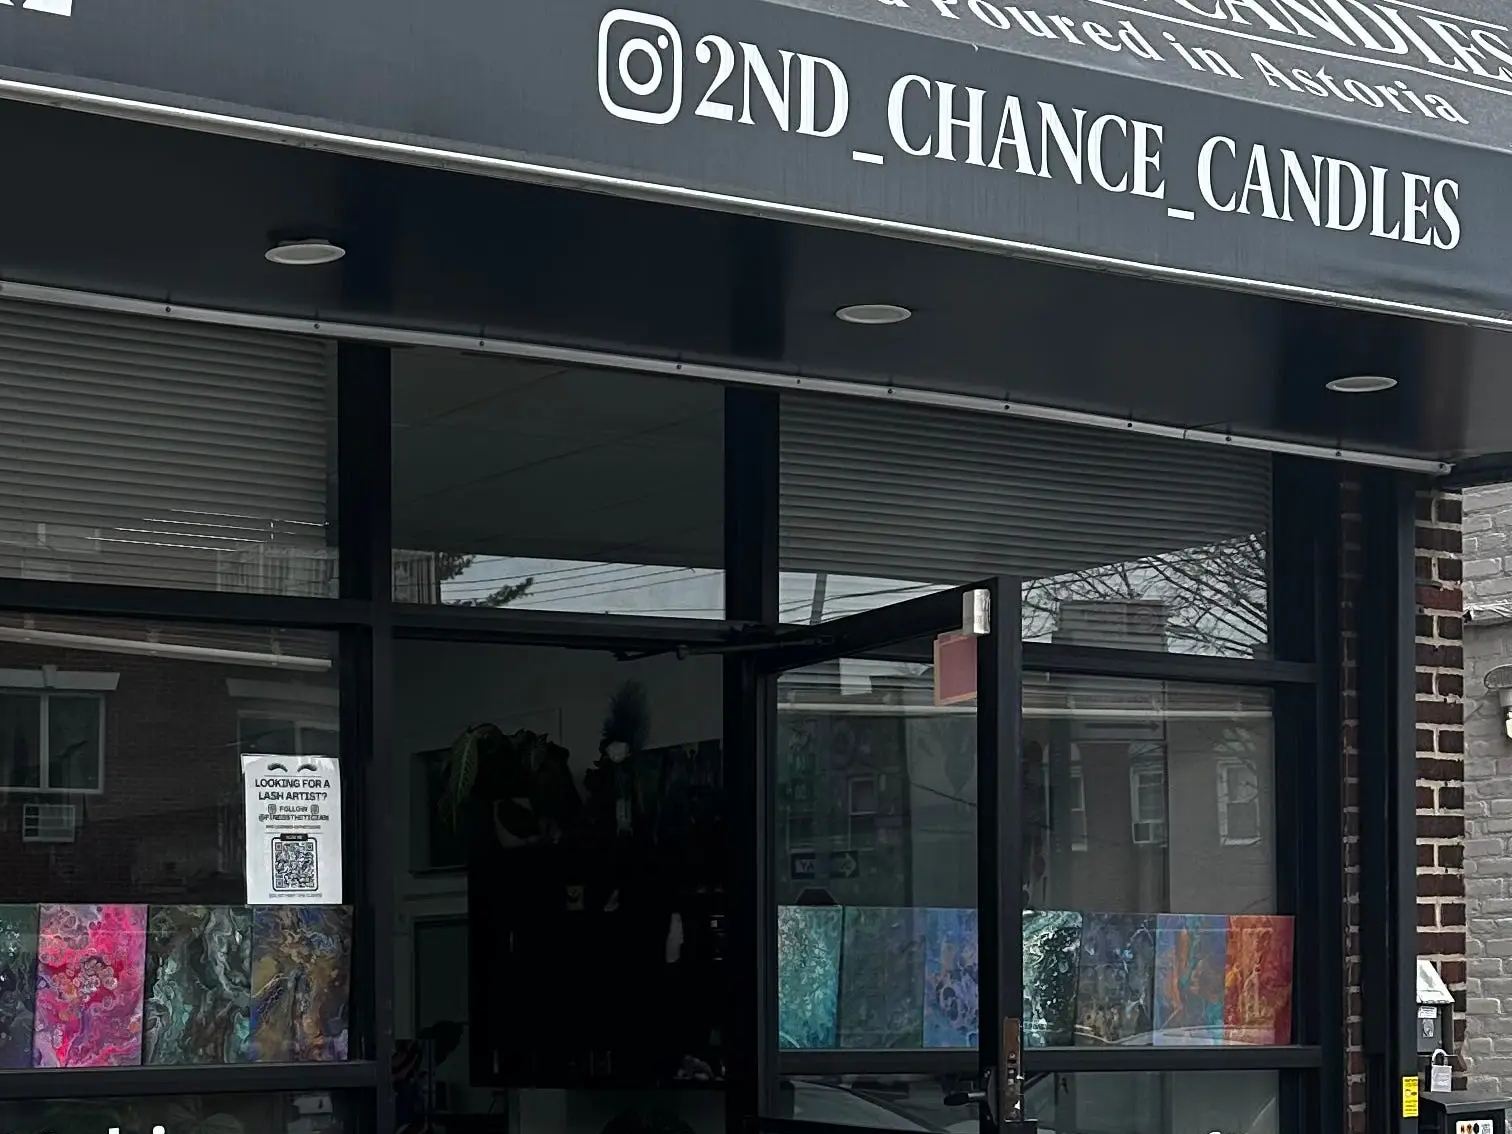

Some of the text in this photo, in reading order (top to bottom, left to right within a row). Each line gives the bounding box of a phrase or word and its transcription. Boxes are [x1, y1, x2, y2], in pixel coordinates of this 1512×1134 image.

[1162, 31, 1244, 80] in
[1250, 52, 1470, 125] Astoria
[694, 34, 1461, 250] 2ND_CHANCE_CANDLES
[255, 779, 331, 789] LOOKING FOR A
[259, 791, 328, 801] LASH ARTIST?
